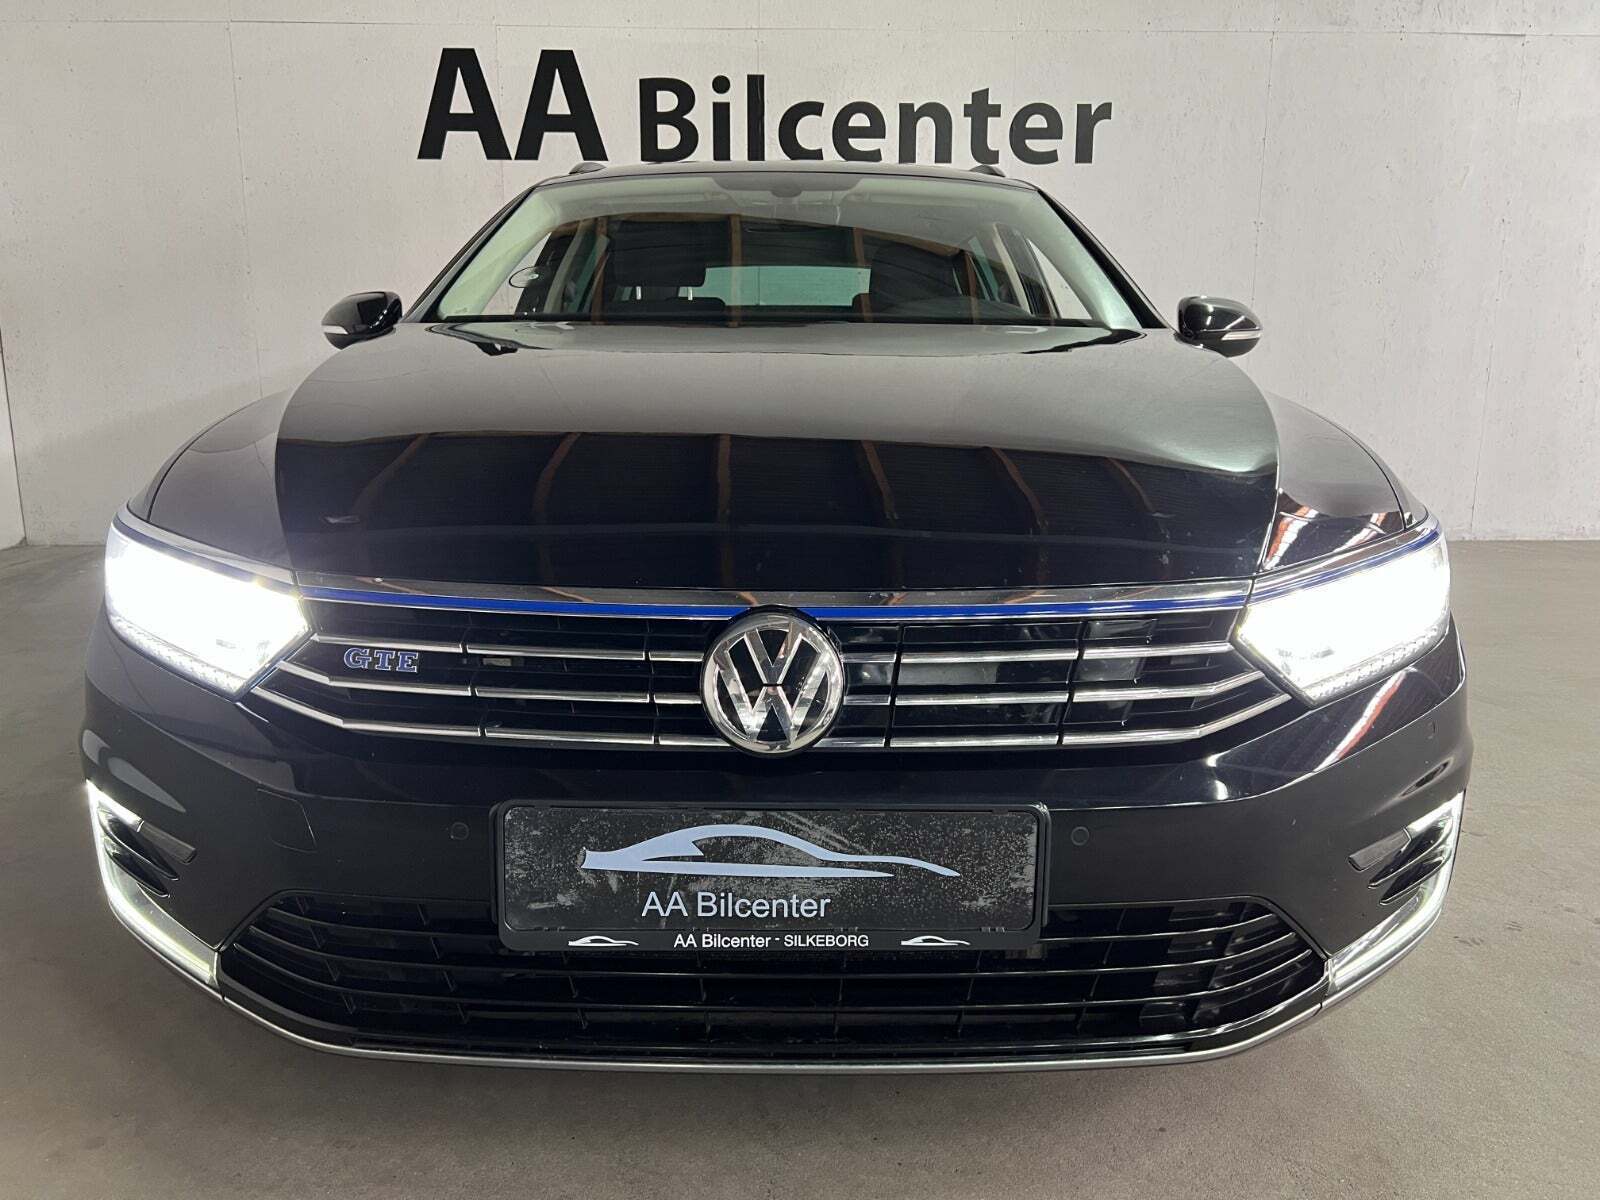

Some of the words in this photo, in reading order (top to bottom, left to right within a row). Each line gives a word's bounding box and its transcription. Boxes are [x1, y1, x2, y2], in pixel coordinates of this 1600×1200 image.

[417, 47, 608, 160] AA
[639, 73, 1113, 164] Bilcenter
[343, 647, 419, 674] GTE
[641, 892, 688, 917] AA
[697, 892, 831, 918] Bilcenter
[673, 934, 697, 948] AA
[701, 934, 771, 948] Bilcenter
[783, 934, 869, 947] SILKEBORG
